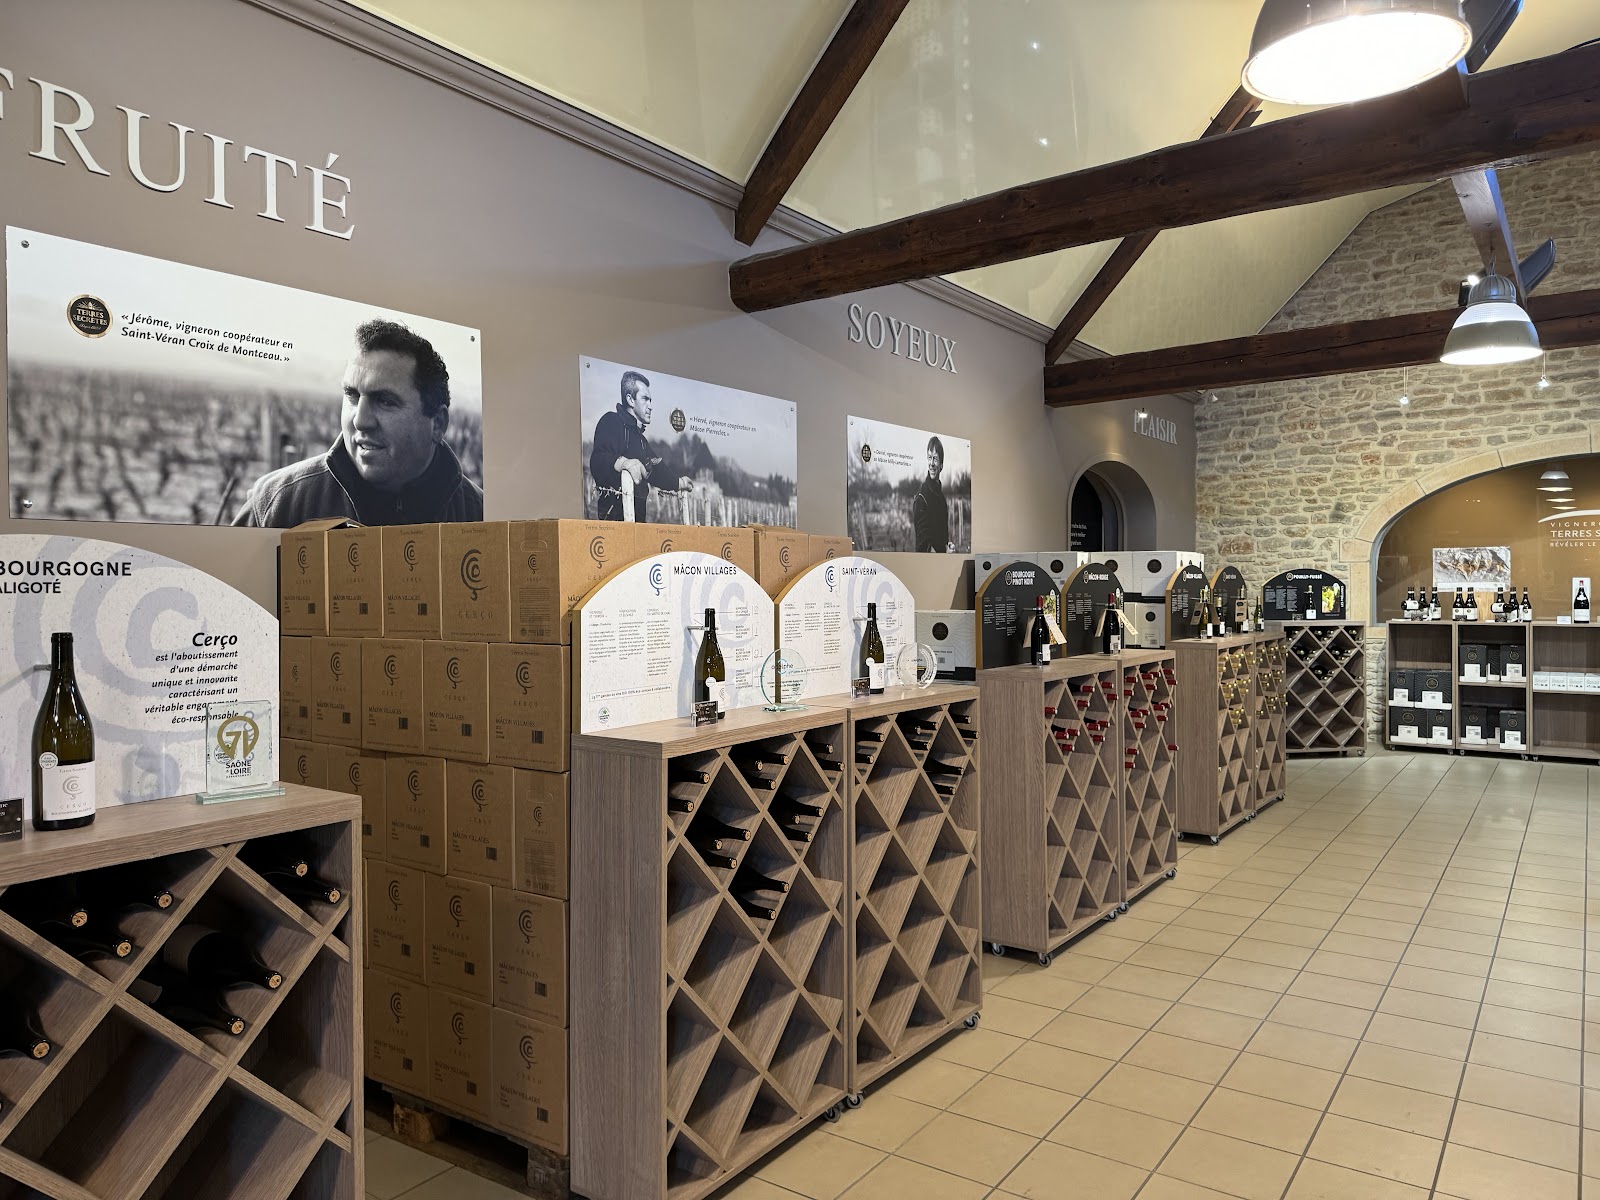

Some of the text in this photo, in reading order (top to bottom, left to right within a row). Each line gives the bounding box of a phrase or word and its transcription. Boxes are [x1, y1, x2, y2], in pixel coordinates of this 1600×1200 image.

[0, 66, 355, 241] RUITÉ
[76, 308, 104, 319] TERRES
[128, 312, 172, 330] Jérôme,
[175, 321, 220, 337] vigneron
[223, 330, 281, 348] coopérateur
[282, 340, 294, 350] en
[121, 327, 186, 346] Saint-Véran
[188, 338, 215, 351] Croix
[217, 341, 229, 353] de
[848, 302, 958, 374] SOYEUX
[1550, 530, 1592, 538] TERRES
[673, 563, 737, 576] MÂCON VILLAGES
[841, 566, 877, 577] SAINT-VÉRAN
[0, 578, 61, 594] LIGOTÉ
[192, 632, 238, 650] Cerço
[155, 650, 238, 661] est l'aboutissement
[169, 662, 238, 674] d'une démarche
[151, 676, 238, 689] unique et innovante
[168, 687, 225, 699] caractérisant
[145, 702, 184, 714] véritable
[225, 760, 252, 769] SAÔNE
[230, 767, 252, 775] LOIRE
